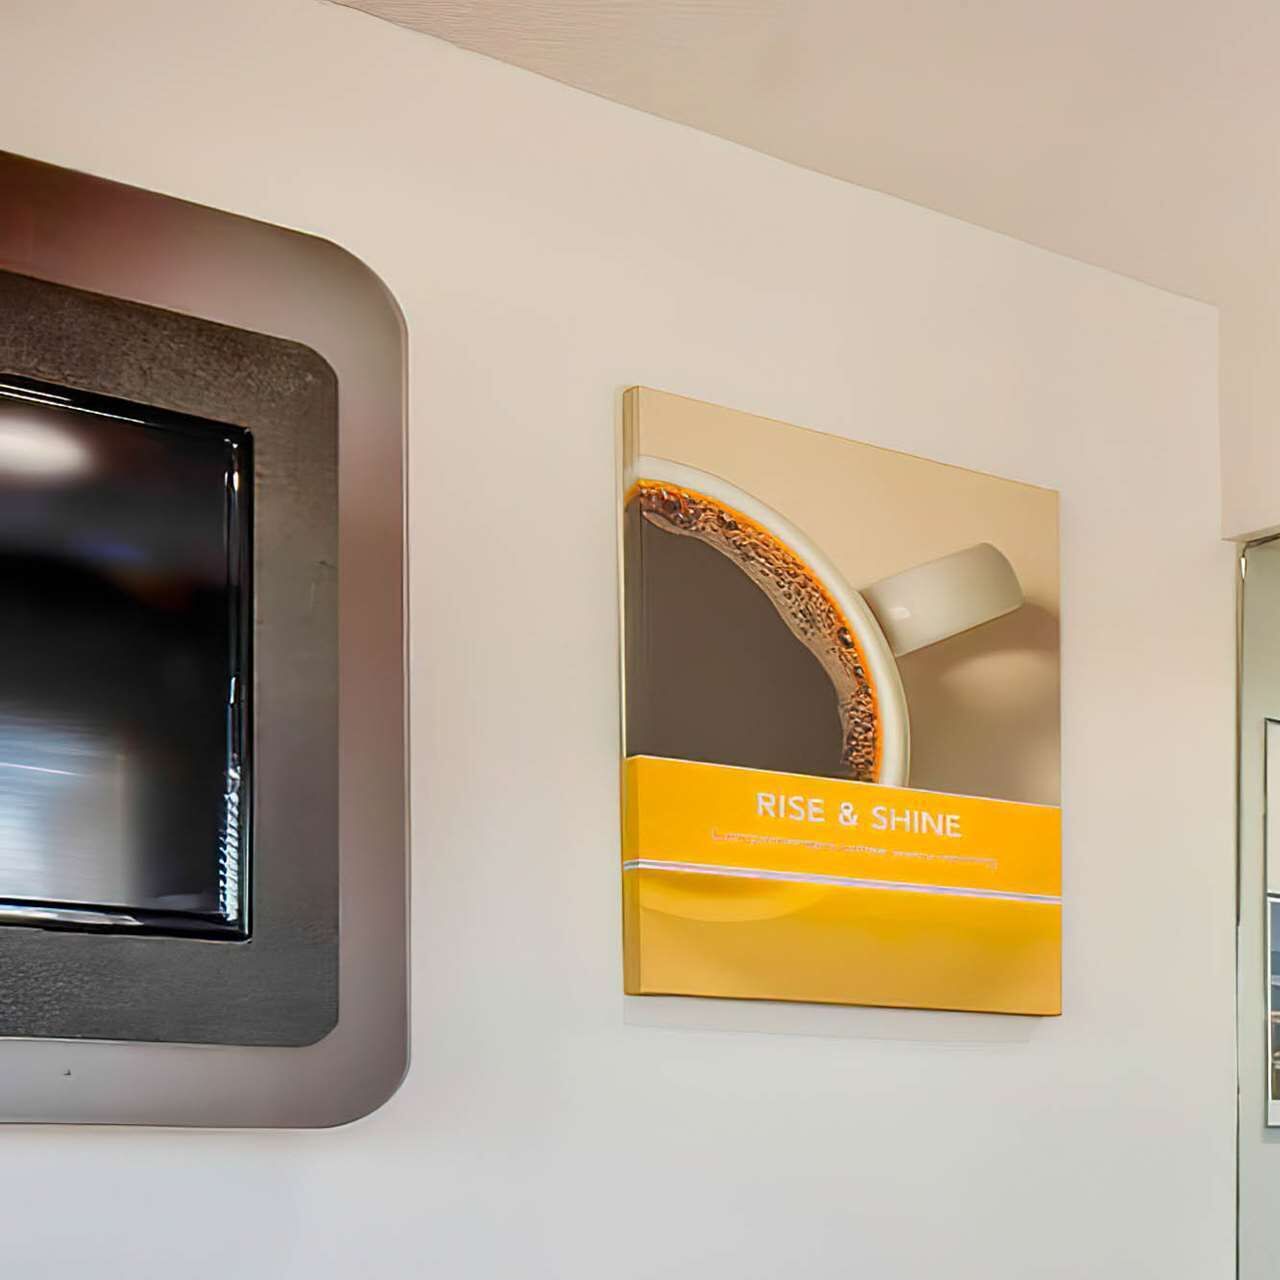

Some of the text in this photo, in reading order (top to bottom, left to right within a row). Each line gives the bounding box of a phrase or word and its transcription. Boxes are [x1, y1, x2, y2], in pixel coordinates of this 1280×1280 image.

[756, 792, 963, 838] RISE & SHINE
